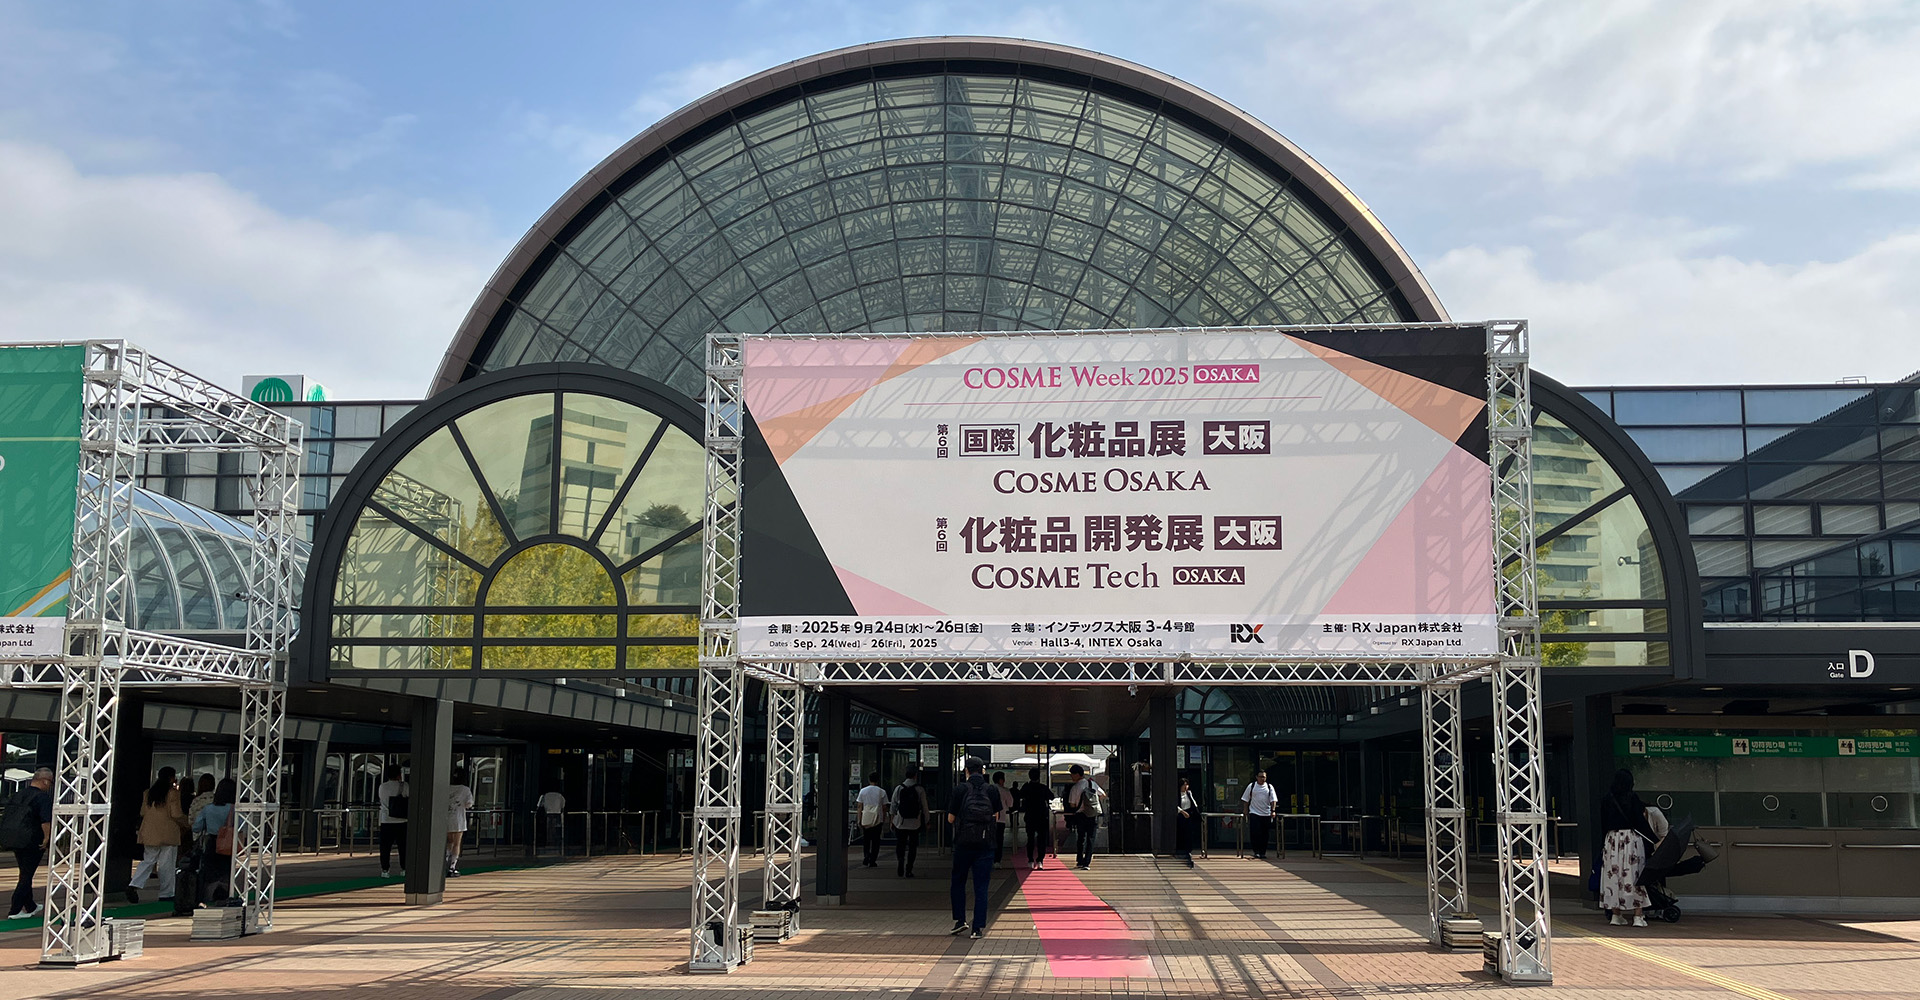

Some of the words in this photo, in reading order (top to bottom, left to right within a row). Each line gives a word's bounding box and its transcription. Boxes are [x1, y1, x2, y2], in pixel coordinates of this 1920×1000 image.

[963, 366, 1061, 389] COSME
[1070, 365, 1134, 387] Week
[1138, 367, 1189, 386] 2025
[1195, 367, 1258, 382] OSAKA
[964, 428, 1015, 453] 国際
[1028, 421, 1186, 459] 化粧品展
[1208, 425, 1266, 450] 大阪
[993, 469, 1097, 494] COSME
[1104, 468, 1210, 493] OSAKA
[1219, 520, 1276, 546] 大阪
[971, 564, 1080, 589] COSME
[1086, 562, 1160, 589] Tech
[1174, 568, 1243, 584] OSAKA
[1045, 620, 1141, 633] インテックス大阪
[1146, 620, 1195, 632] 3-4号館
[1230, 624, 1264, 643] RX
[1352, 622, 1371, 632] RX
[793, 639, 817, 650] Sep.
[910, 639, 938, 648] 2025
[1041, 638, 1084, 648] Hall3-4,
[1089, 638, 1122, 647] INTEX
[1127, 638, 1162, 647] Osaka
[1416, 639, 1444, 647] Japan
[1828, 662, 1845, 670] 入口
[1848, 650, 1875, 678] D
